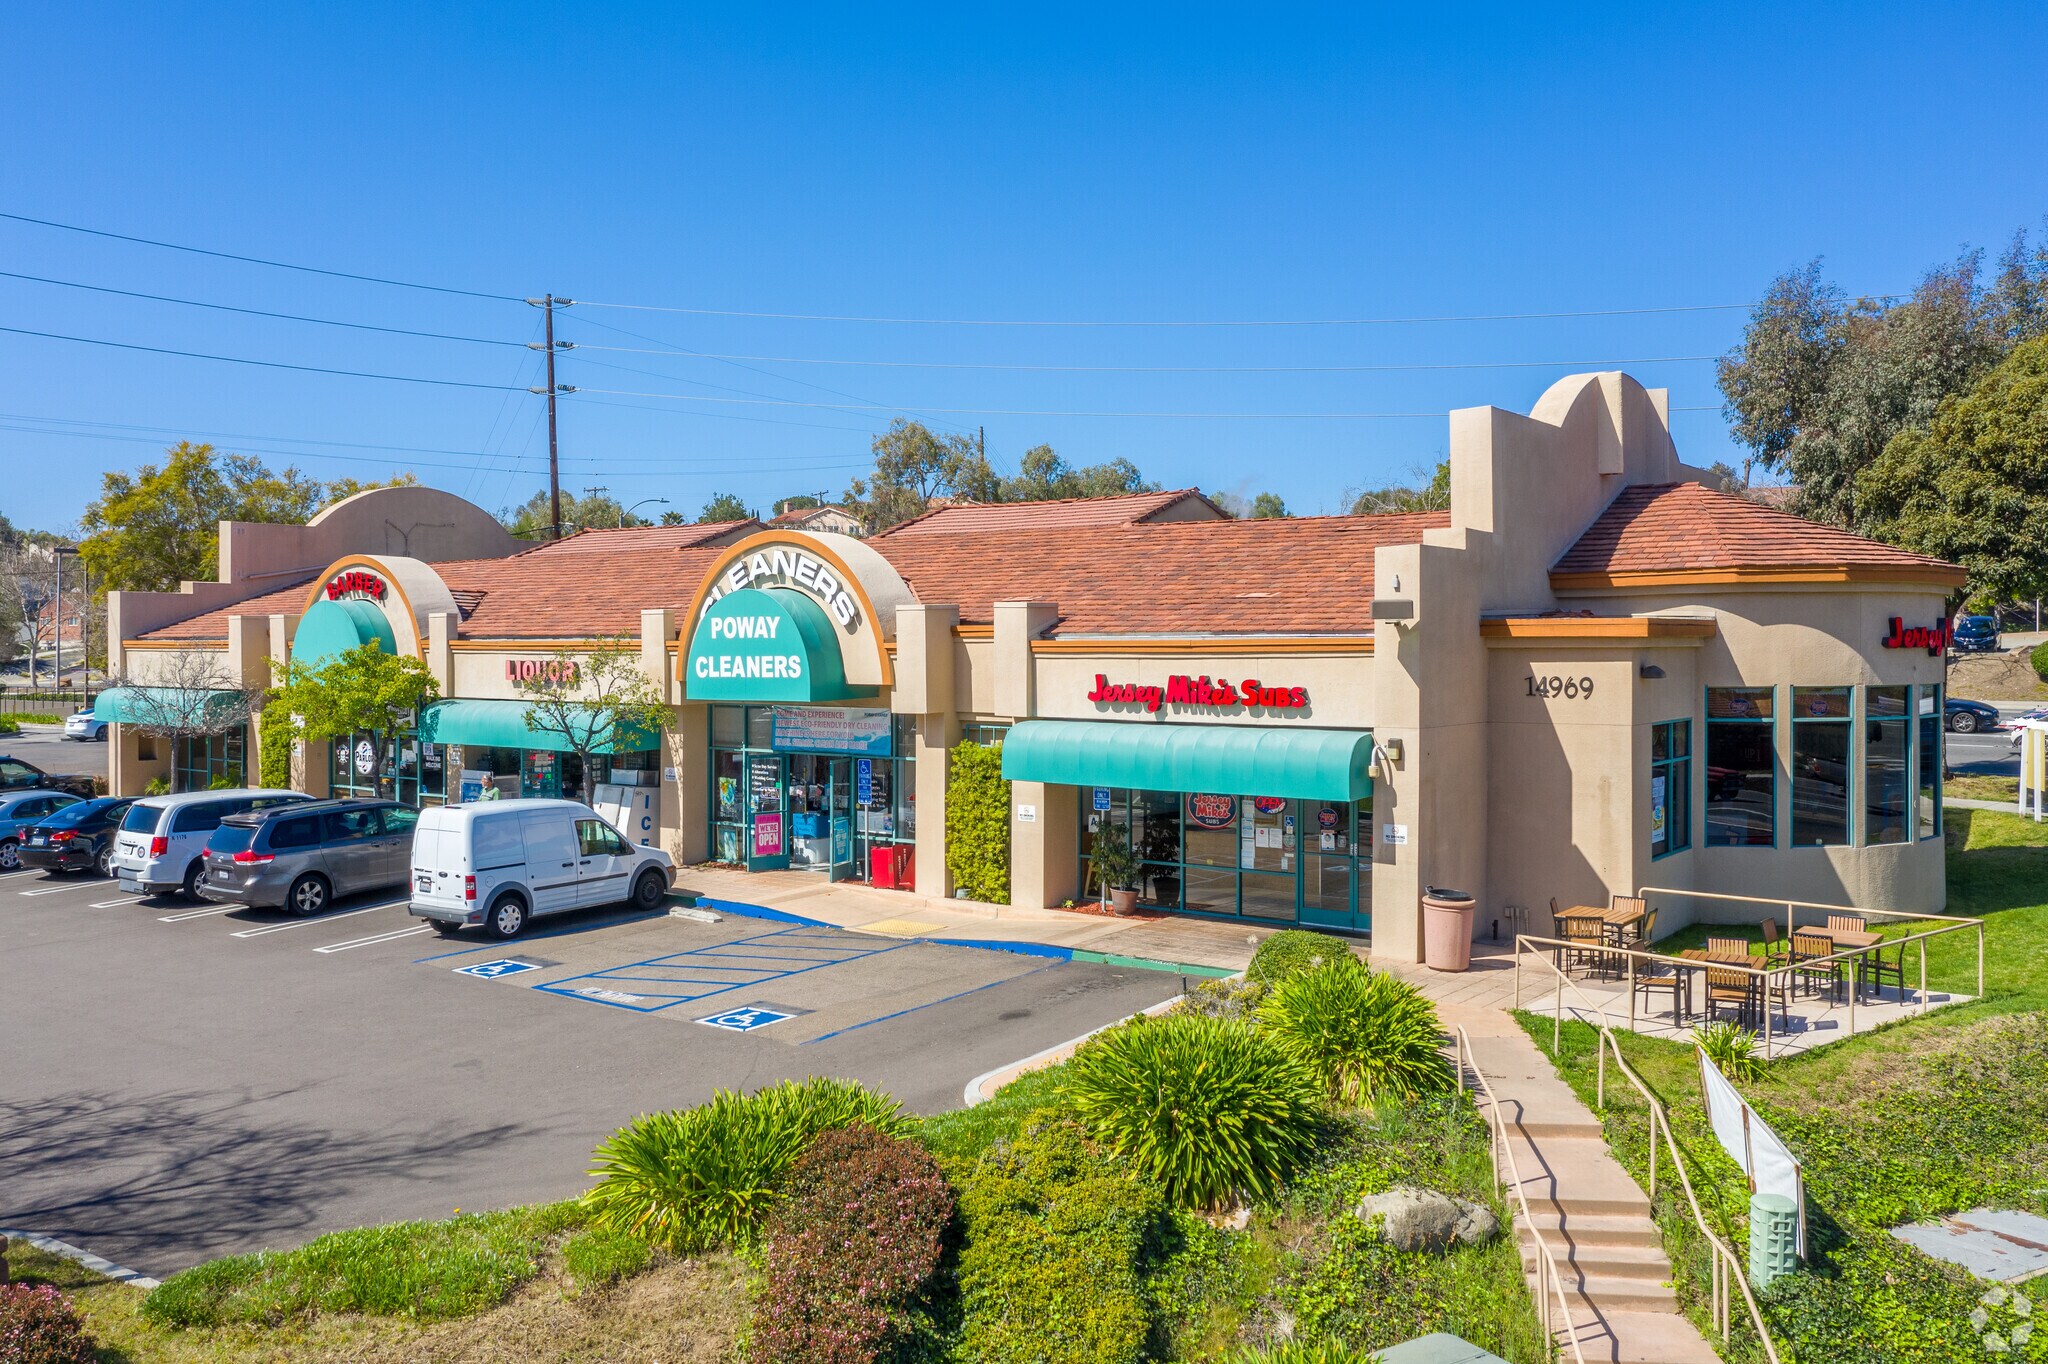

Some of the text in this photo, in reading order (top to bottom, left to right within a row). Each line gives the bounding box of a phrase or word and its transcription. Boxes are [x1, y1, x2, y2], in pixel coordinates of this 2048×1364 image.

[326, 571, 383, 601] BARBER
[710, 616, 781, 639] POWAY
[1884, 616, 1943, 657] Jersey
[505, 659, 576, 684] LIQUOR
[695, 655, 802, 679] CLEANERS
[1088, 674, 1162, 712] Jersey
[1166, 675, 1239, 706] Mike's
[1524, 676, 1594, 700] 14969
[794, 710, 807, 718] AND
[807, 711, 845, 719] EXPERIENCE!
[776, 719, 888, 731] NEWEST ECO-FRIENDLY DRY CLEANING
[1194, 793, 1231, 809] Jersey
[1255, 796, 1283, 809] OPEN
[760, 823, 778, 832] WE'RE
[1091, 817, 1097, 826] A
[759, 833, 779, 846] OPEN
